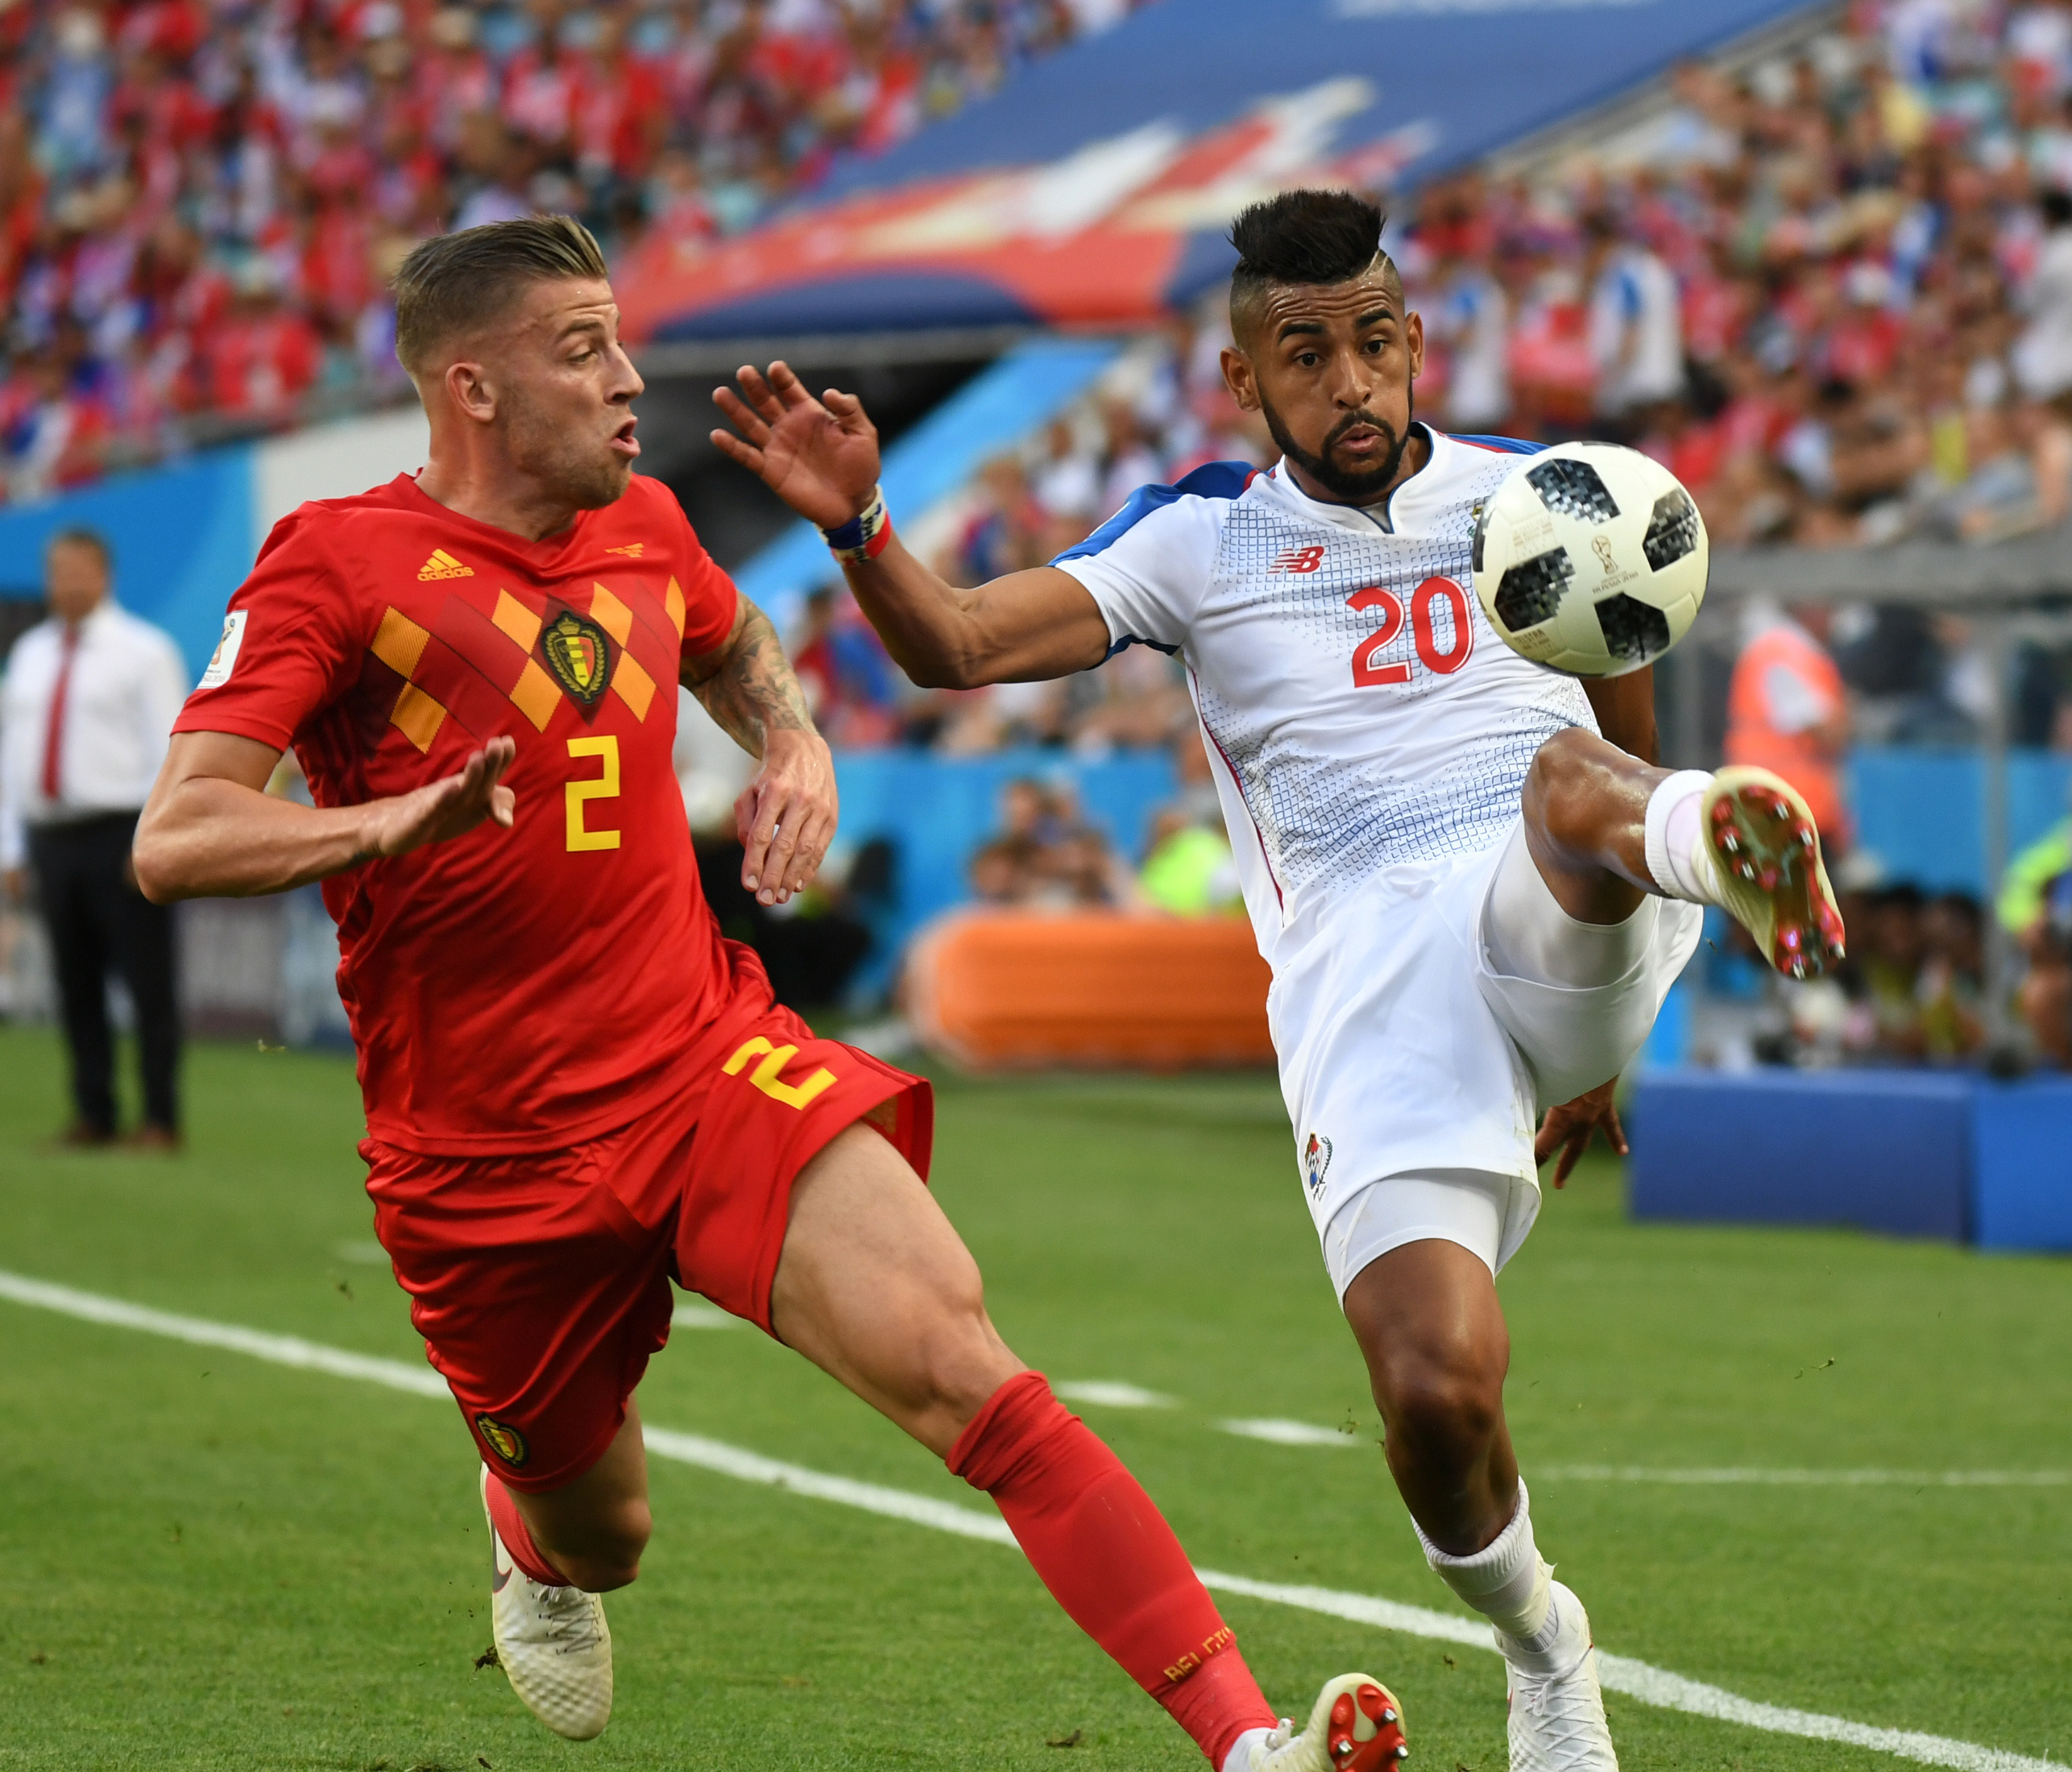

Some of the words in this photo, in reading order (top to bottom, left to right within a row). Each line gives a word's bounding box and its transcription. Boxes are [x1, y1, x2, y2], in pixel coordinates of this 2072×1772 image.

[416, 566, 475, 582] adidas
[1345, 574, 1474, 689] 20
[565, 735, 621, 852] 2
[720, 1036, 839, 1111] 2
